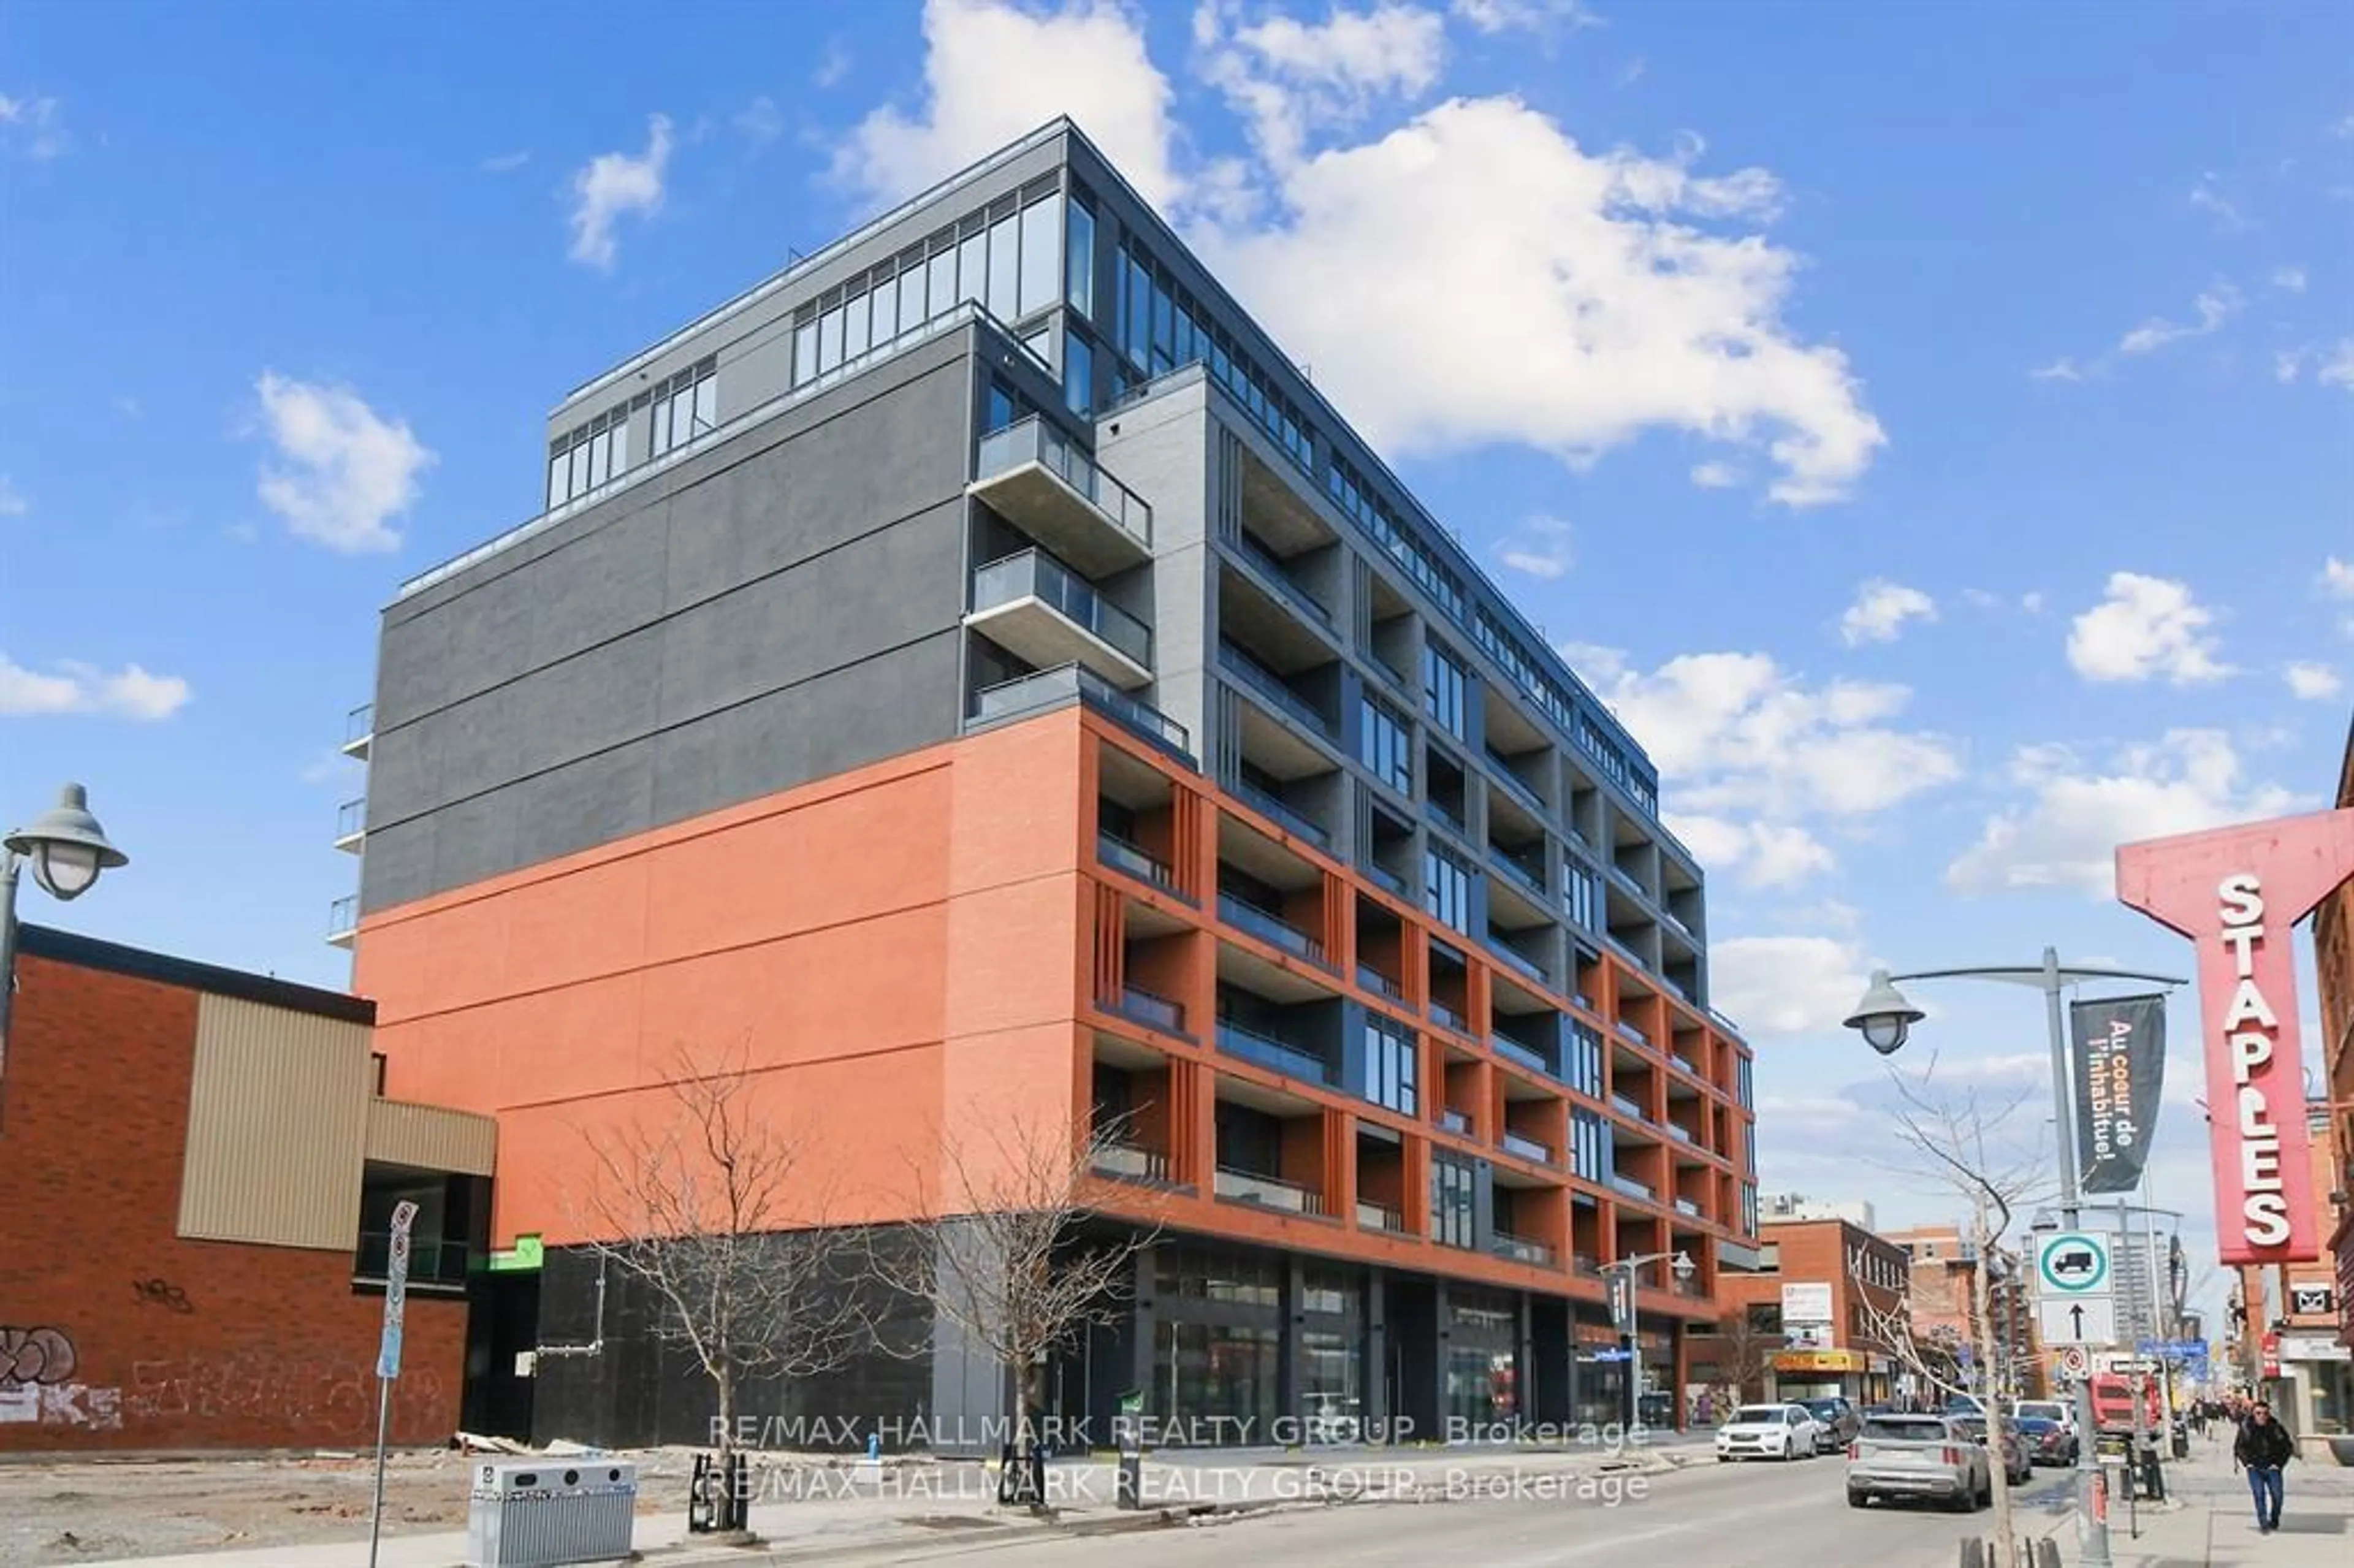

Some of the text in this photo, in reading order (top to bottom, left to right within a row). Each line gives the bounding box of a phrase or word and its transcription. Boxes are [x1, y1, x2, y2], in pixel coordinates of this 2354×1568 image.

[2109, 1020, 2132, 1051] Au
[2219, 873, 2291, 1247] STAPLES
[2115, 1119, 2139, 1146] de
